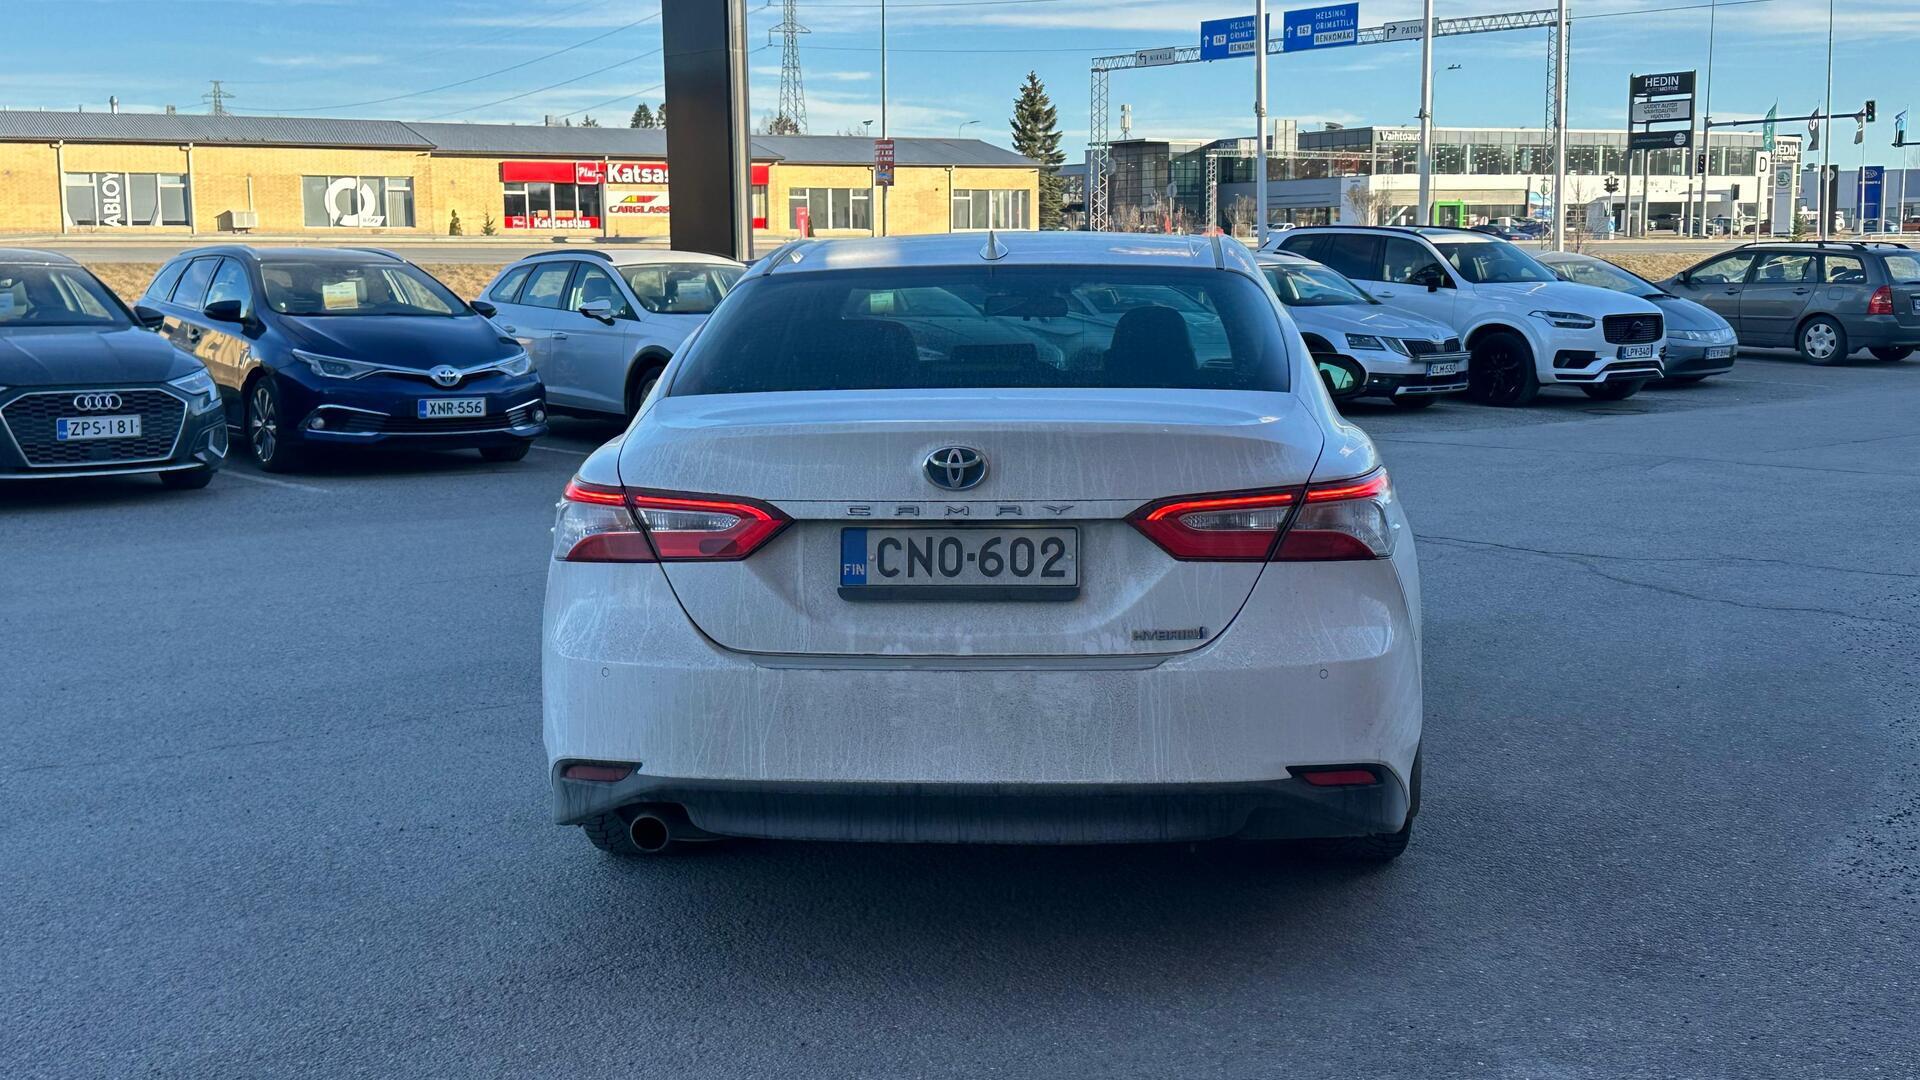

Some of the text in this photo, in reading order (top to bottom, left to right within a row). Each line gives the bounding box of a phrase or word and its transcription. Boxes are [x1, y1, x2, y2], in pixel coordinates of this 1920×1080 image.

[1315, 9, 1346, 20] HELSINKI
[1315, 19, 1354, 30] ORIMATTILA
[1299, 26, 1309, 35] 167
[1214, 36, 1225, 45] 167
[1645, 76, 1679, 87] HEDIN
[102, 173, 123, 227] ABLOY
[429, 401, 482, 415] XNR-556
[70, 419, 134, 437] ZPS-181
[846, 505, 1075, 517] CAMRY
[843, 536, 1066, 578] FIN CNO-602
